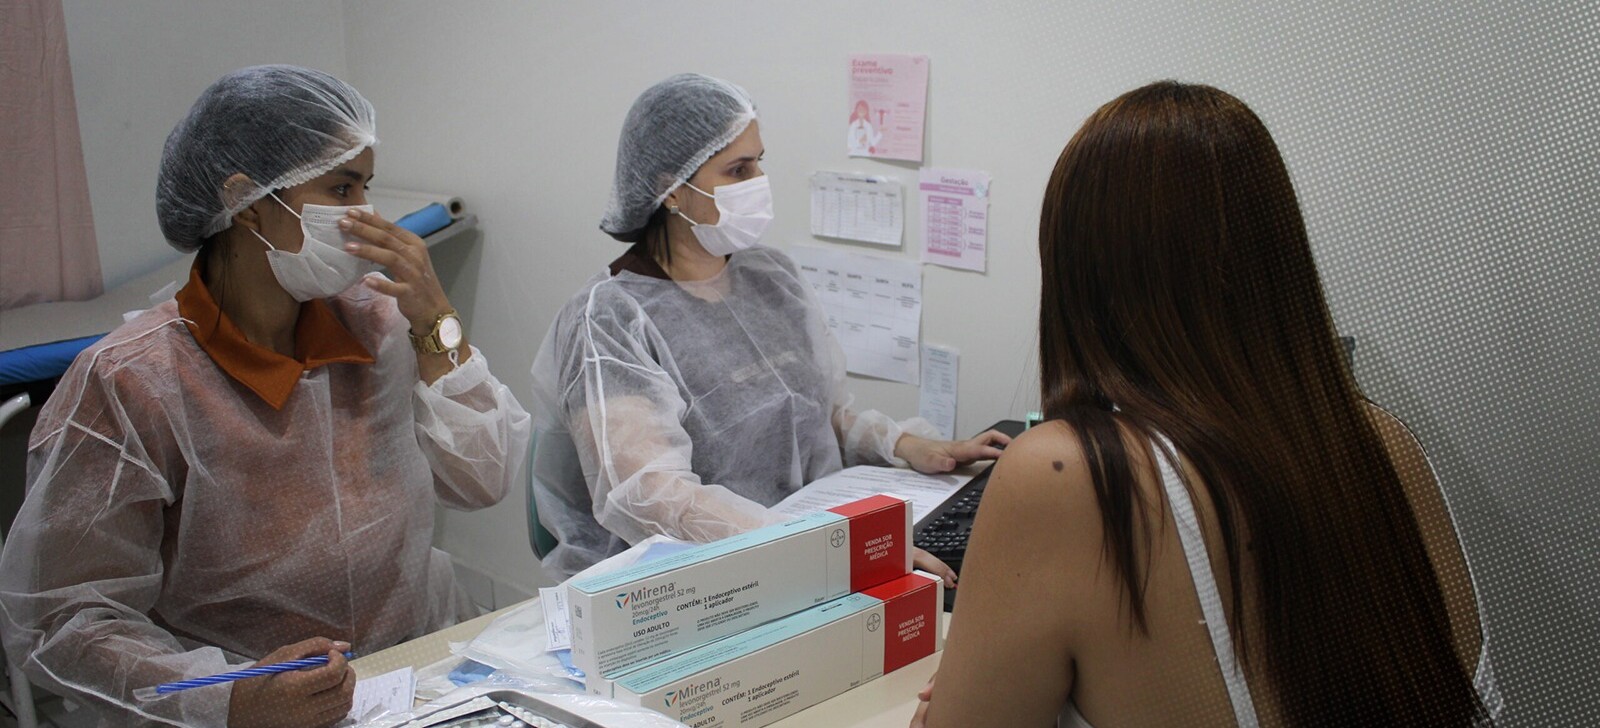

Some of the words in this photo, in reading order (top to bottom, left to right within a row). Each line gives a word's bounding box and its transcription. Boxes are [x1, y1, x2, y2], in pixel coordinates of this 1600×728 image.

[852, 59, 877, 67] Exame
[852, 66, 893, 75] preventivo
[941, 176, 968, 186] Gestação
[864, 538, 881, 548] VENDA
[882, 533, 892, 543] SOB
[864, 541, 894, 556] PRESCRIÇÃO
[869, 550, 888, 561] MÉDICA
[630, 581, 674, 602] Mirena
[631, 591, 676, 611] levonorgestrel
[677, 589, 686, 598] 52
[686, 586, 696, 596] mg
[676, 597, 703, 612] CONTÉM:
[708, 587, 742, 602] Endoceptivo
[742, 580, 759, 591] estéril
[708, 597, 734, 610] aplicador
[632, 610, 668, 625] Endoceptivo
[898, 619, 914, 630] VENDA
[914, 614, 924, 624] SOB
[633, 628, 646, 638] USO
[646, 621, 670, 634] ADULTO
[897, 621, 925, 637] PRESCRIÇÃO
[902, 630, 921, 643] MÉDICA
[678, 677, 721, 700] Mirena
[679, 688, 721, 708] levonorgestrel
[722, 683, 731, 692] 52
[731, 679, 741, 689] mg
[721, 692, 747, 706] CONTÉM:
[752, 678, 783, 695] Endoceptivo
[783, 670, 800, 681] estéril
[752, 687, 776, 702] aplicador
[680, 705, 714, 722] Endoceptivo
[693, 715, 716, 728] ADULTO
